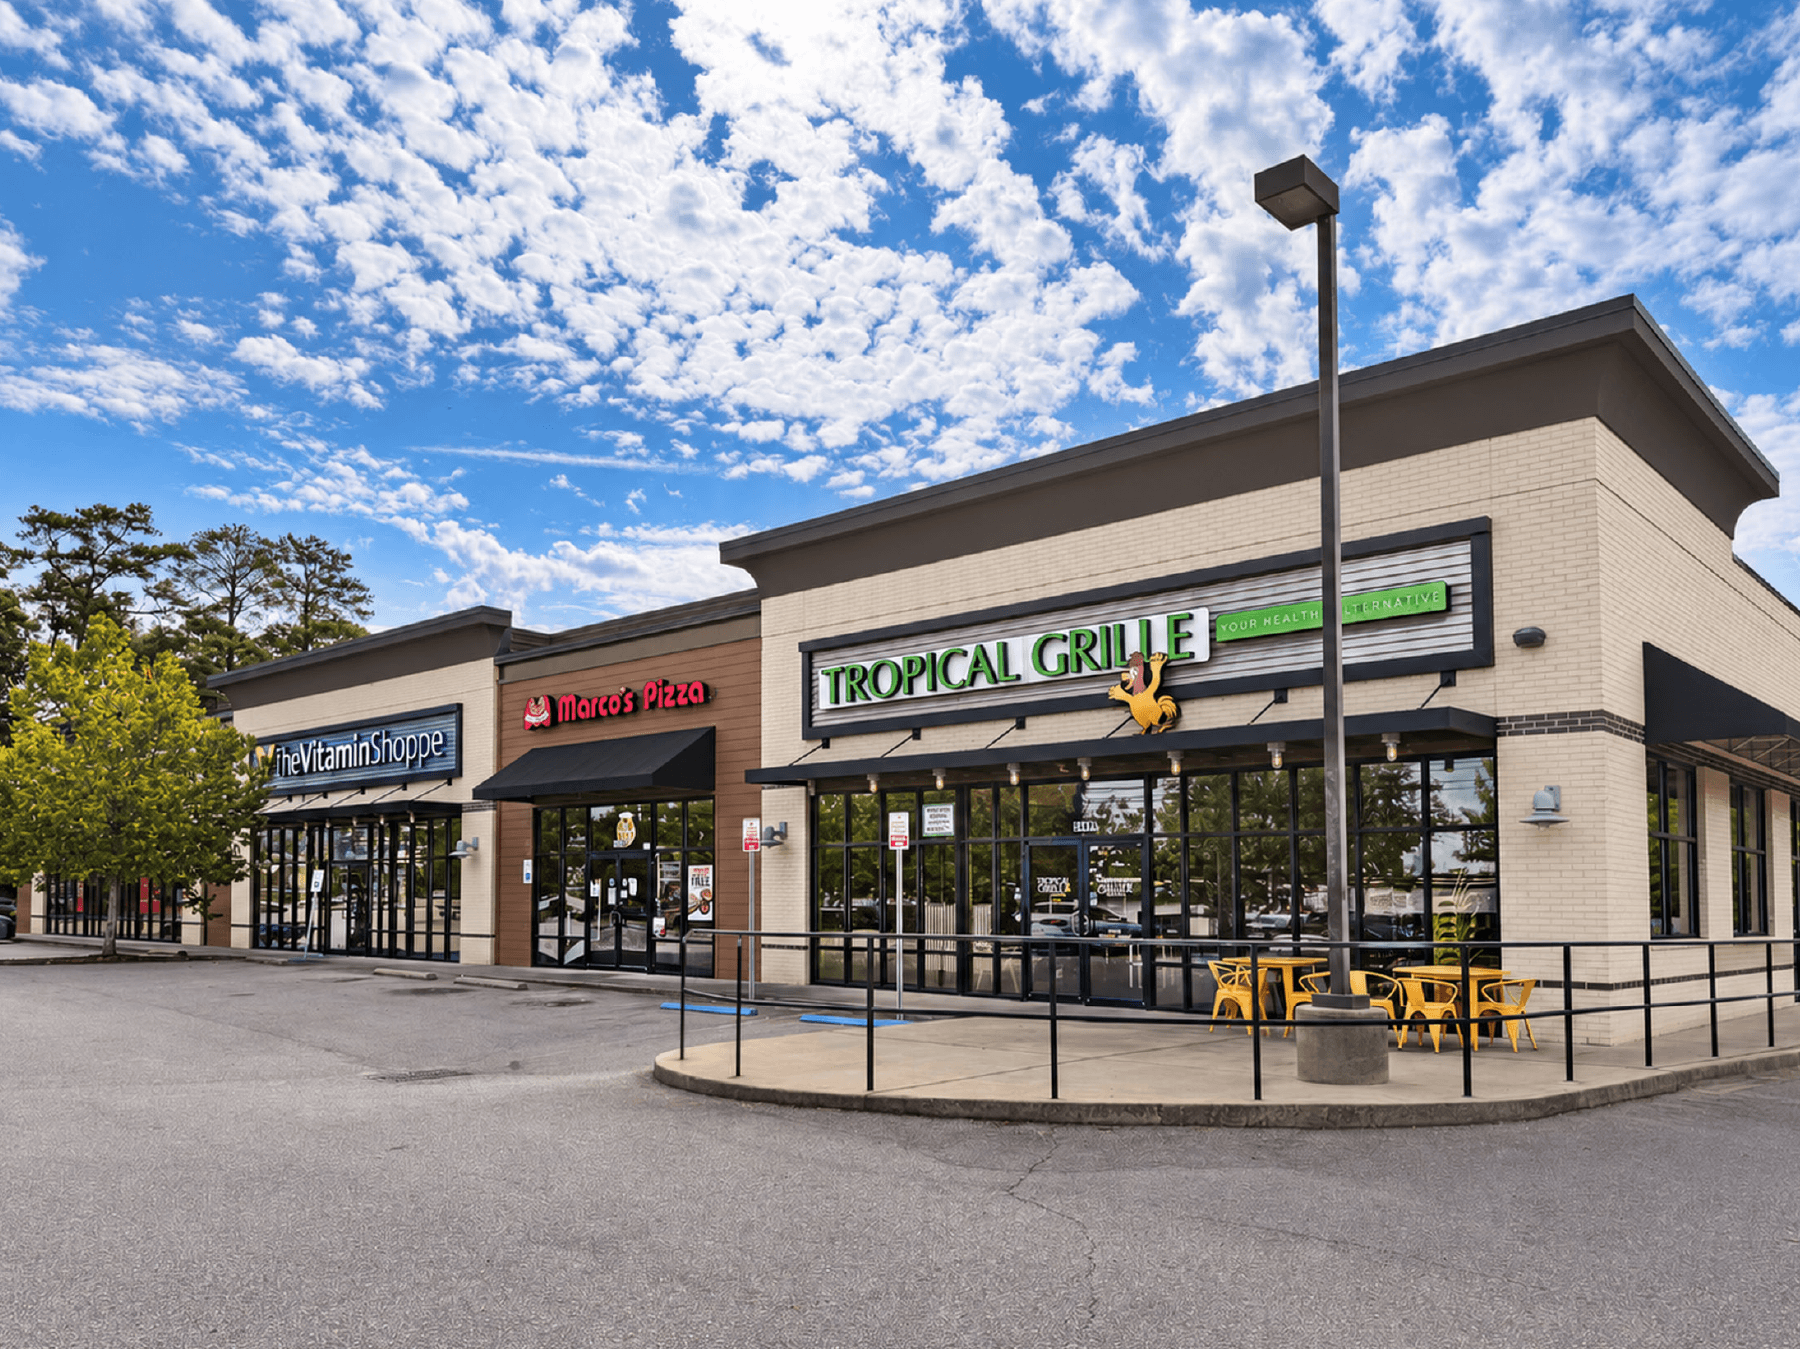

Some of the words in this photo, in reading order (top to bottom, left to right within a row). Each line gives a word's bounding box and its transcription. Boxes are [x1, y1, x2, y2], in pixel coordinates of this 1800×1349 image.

[1221, 618, 1257, 633] YOUR
[1263, 609, 1319, 627] HEALTH
[1344, 591, 1440, 614] LTERNATIVE
[821, 641, 1021, 704] TROPICAL
[1031, 613, 1195, 677] GRILLE
[558, 687, 634, 723] Marco's
[643, 679, 705, 710] Pizza
